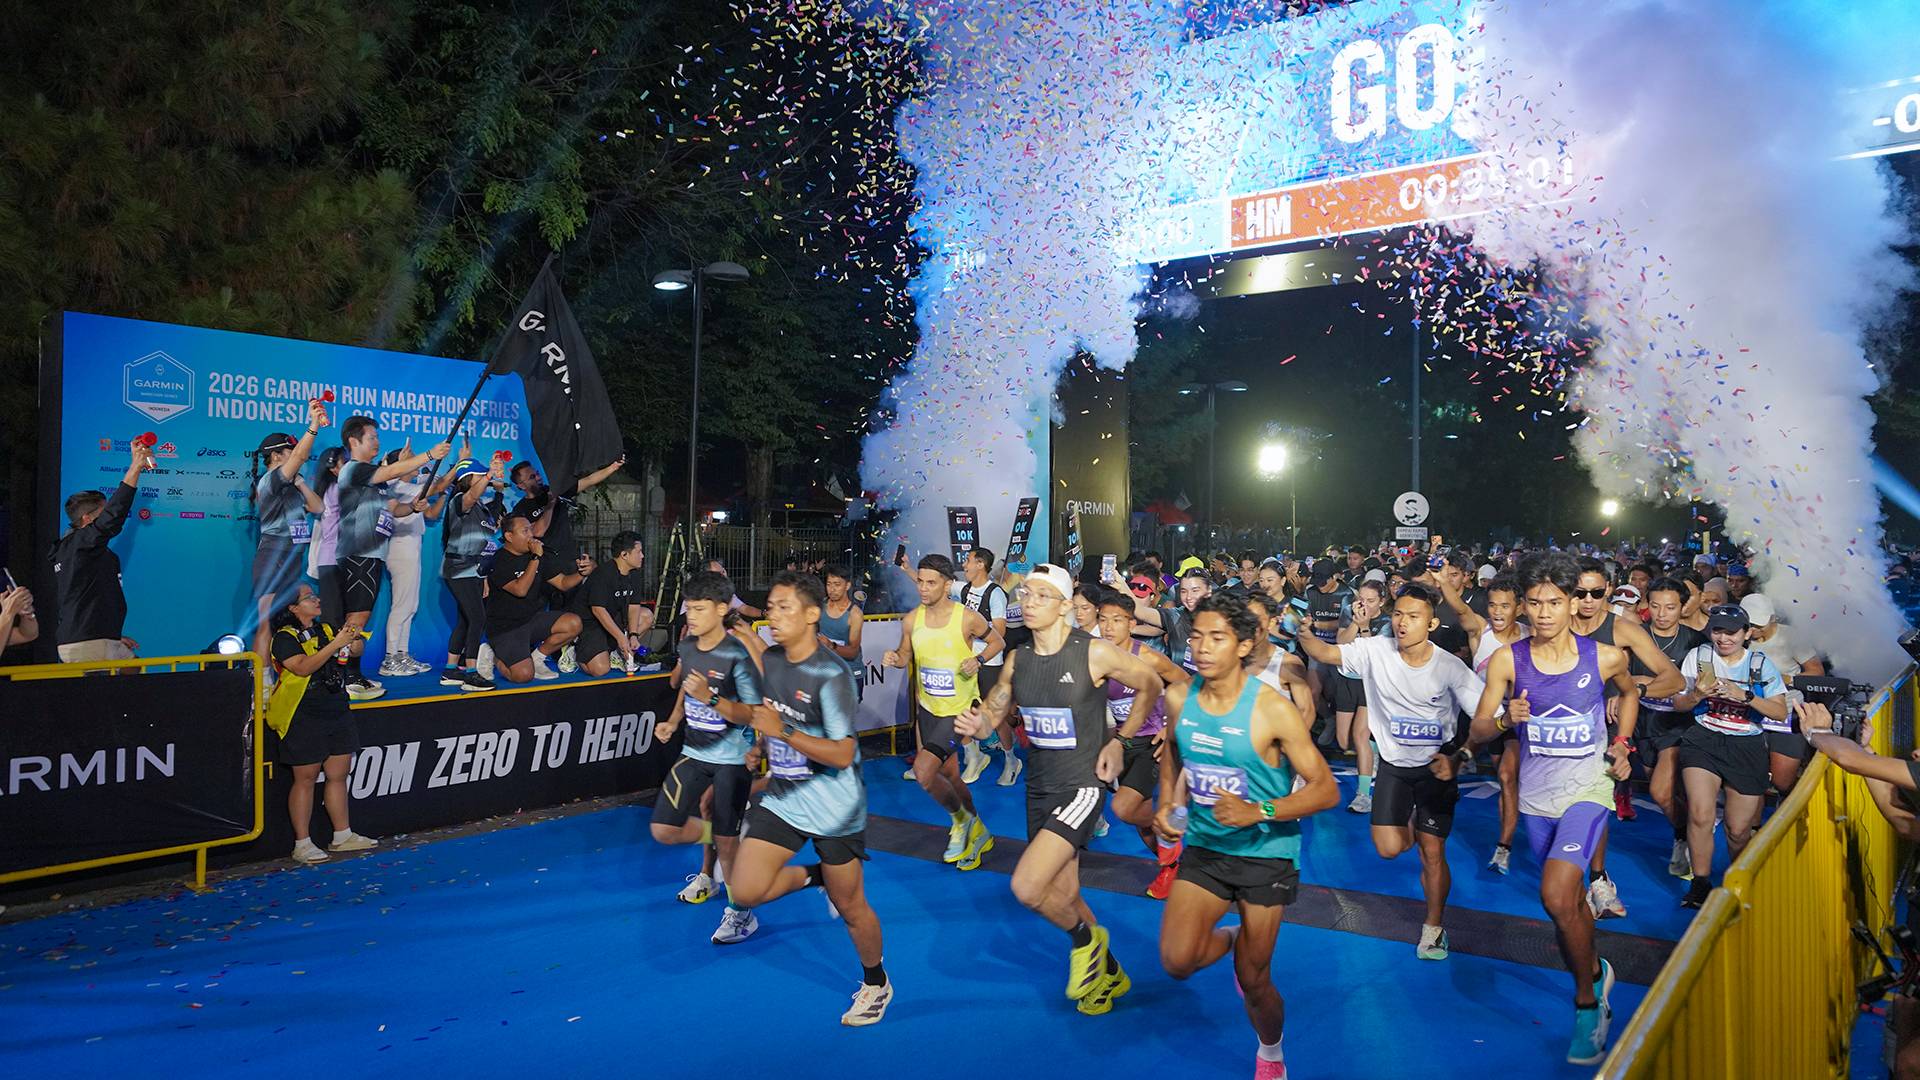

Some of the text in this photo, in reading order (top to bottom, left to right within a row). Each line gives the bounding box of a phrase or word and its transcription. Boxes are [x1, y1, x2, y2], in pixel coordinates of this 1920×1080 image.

[1245, 195, 1292, 240] HM
[134, 379, 184, 391] GARMIN
[208, 371, 520, 420] 2026 GARMIN RUN MARATHON SERIES
[481, 420, 519, 441] 2026
[1066, 500, 1115, 516] GARMIN
[1015, 521, 1027, 532] 0K
[956, 530, 973, 541] 10K
[1068, 532, 1077, 546] 10
[1807, 685, 1836, 693] DEITY
[1034, 715, 1069, 734] 7614
[1402, 722, 1439, 737] 7549
[1544, 724, 1591, 743] 7473
[316, 710, 656, 804] OM ZERO TO HERO
[0, 743, 175, 796] RMIN
